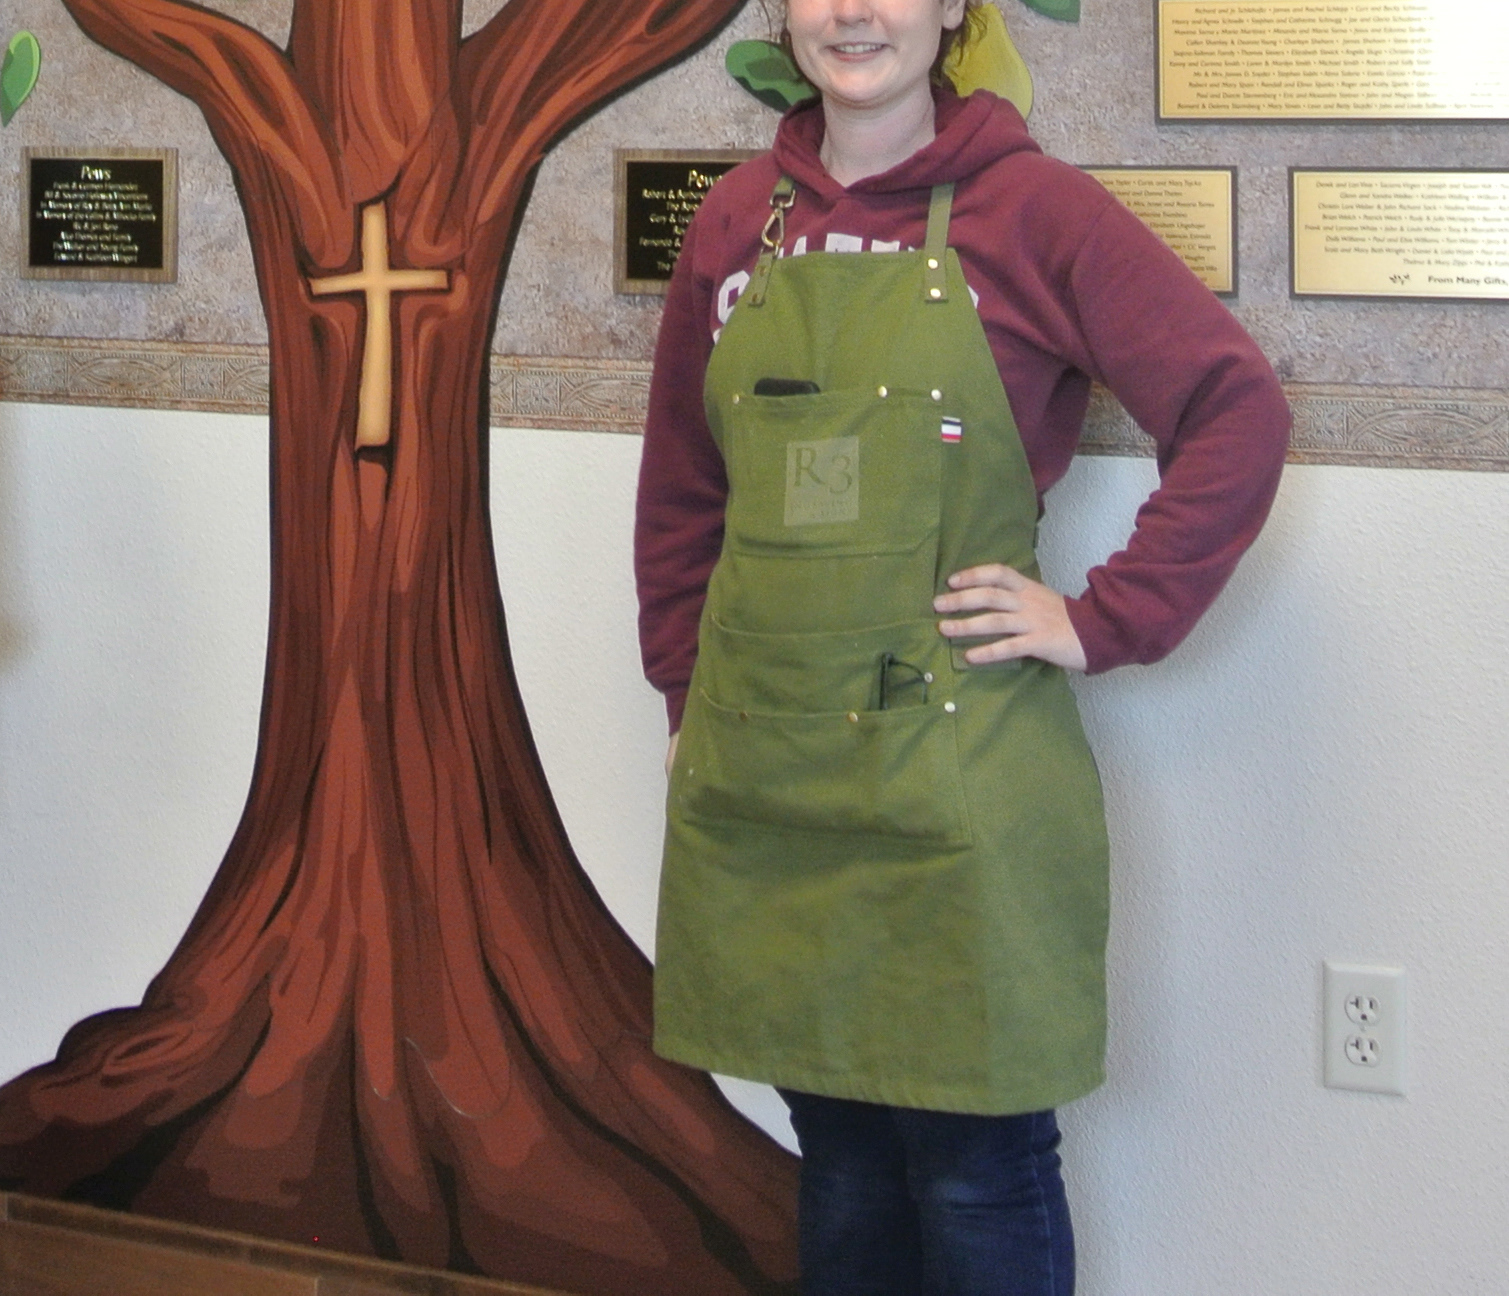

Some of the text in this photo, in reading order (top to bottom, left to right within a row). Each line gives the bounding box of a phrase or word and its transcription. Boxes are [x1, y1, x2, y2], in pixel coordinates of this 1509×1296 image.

[81, 164, 112, 180] Pews
[1428, 275, 1454, 284] From
[1456, 276, 1481, 286] Many
